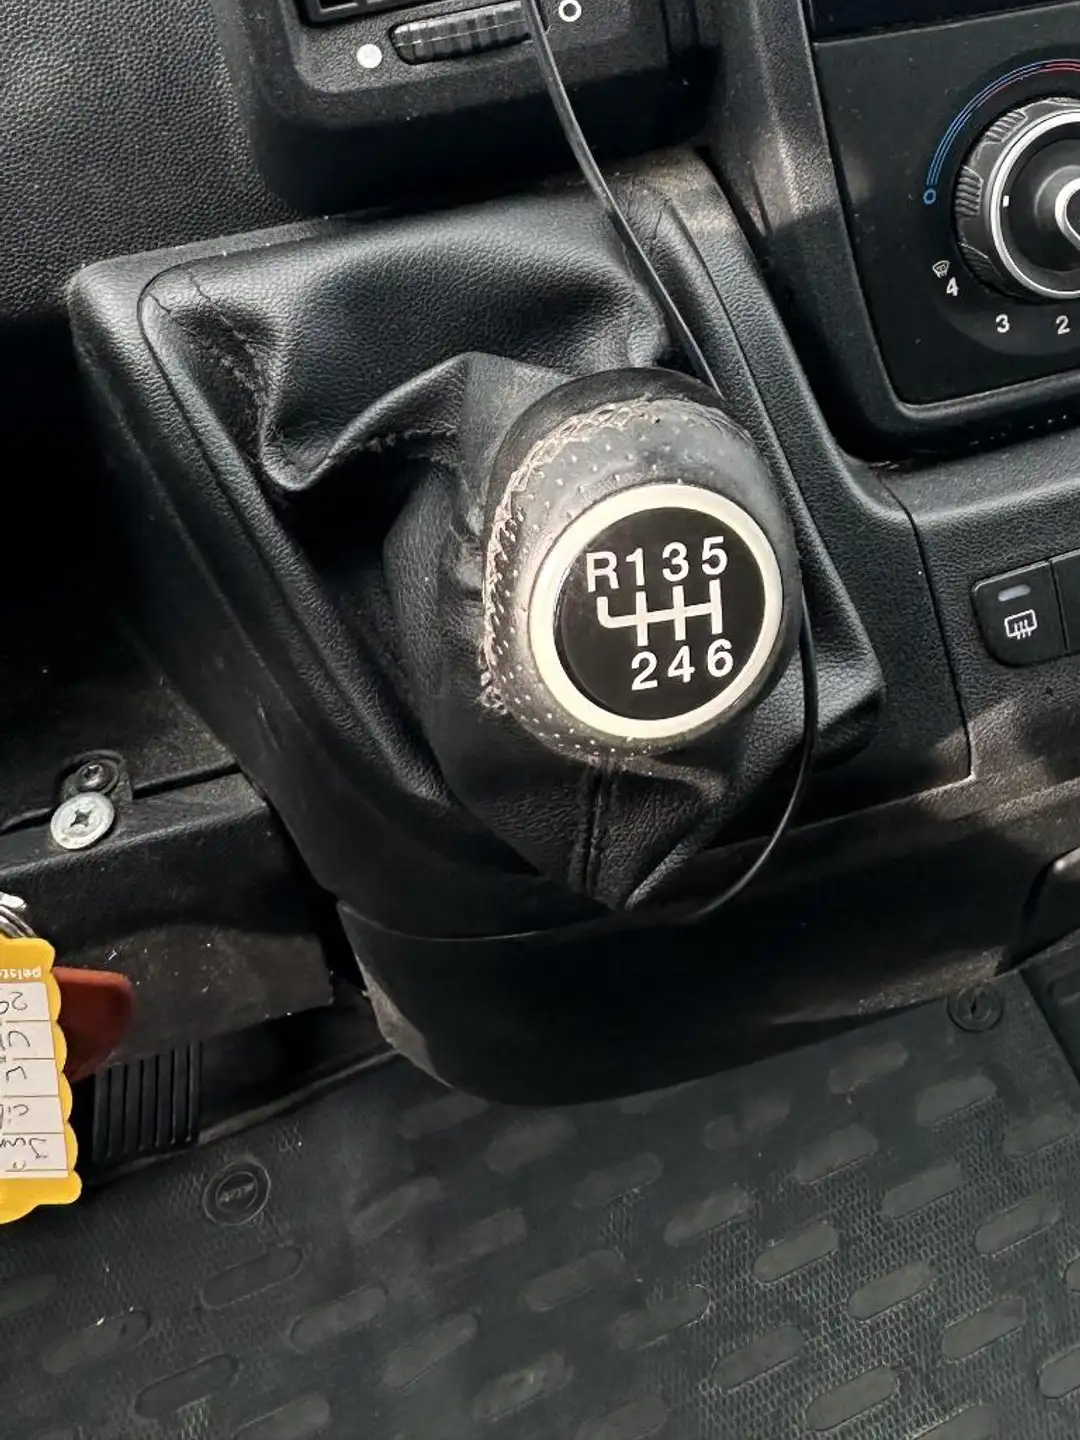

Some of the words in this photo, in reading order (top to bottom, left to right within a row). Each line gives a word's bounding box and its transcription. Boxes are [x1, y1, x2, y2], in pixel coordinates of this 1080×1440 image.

[946, 276, 959, 297] 4
[995, 313, 1011, 334] 3
[1055, 314, 1071, 335] 2
[586, 551, 620, 592] R
[625, 547, 645, 586] 1
[662, 542, 690, 582] 3
[701, 536, 728, 575] 5
[631, 651, 659, 691] 2
[667, 645, 696, 683] 4
[707, 638, 734, 678] 6
